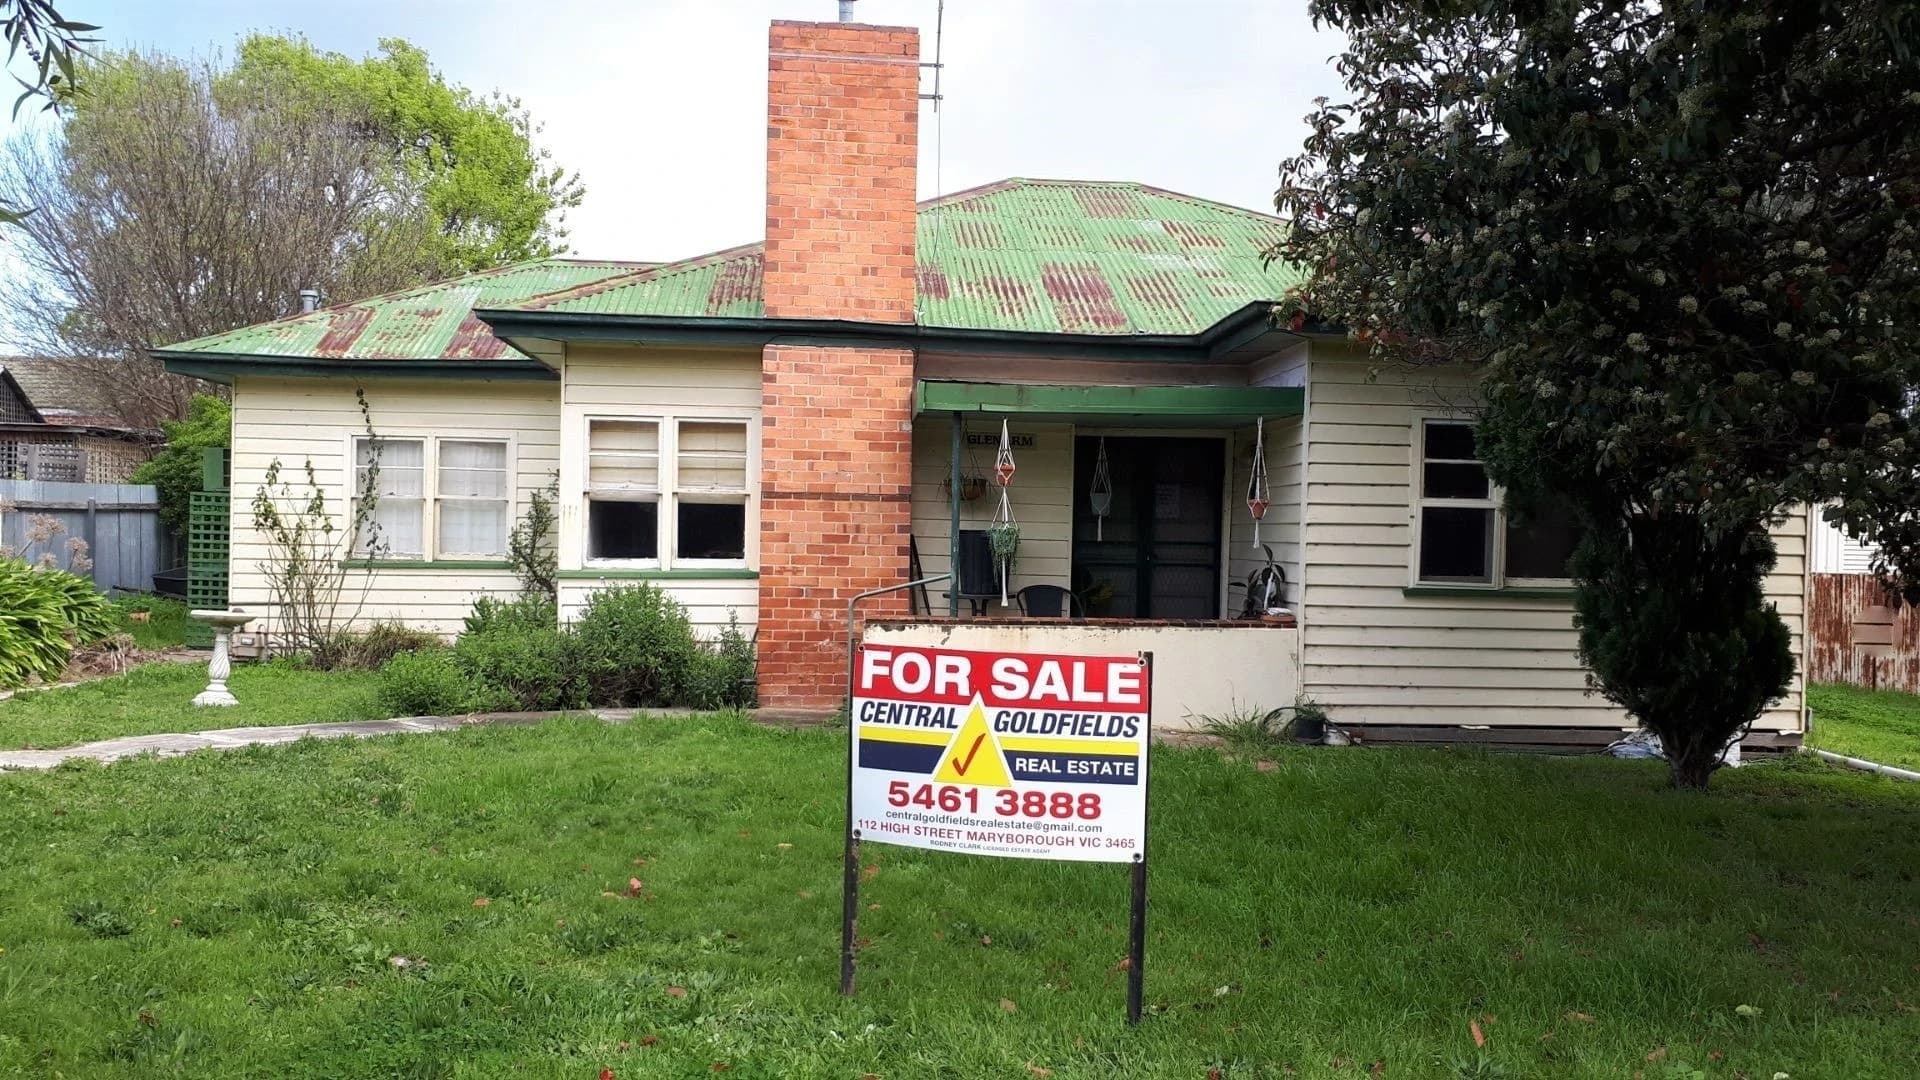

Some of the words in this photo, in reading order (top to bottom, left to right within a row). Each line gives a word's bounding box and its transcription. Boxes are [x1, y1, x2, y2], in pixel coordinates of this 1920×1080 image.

[968, 434, 1033, 446] GLENRM
[861, 650, 971, 696] FOR
[991, 657, 1141, 704] SALE
[860, 701, 958, 729] CENTRAL
[994, 710, 1140, 738] GOLDFIELDS
[1015, 758, 1061, 773] REAL
[1067, 760, 1135, 776] ESTATE
[888, 781, 978, 814] 5461
[995, 789, 1101, 820] 3888
[858, 819, 877, 830] 112
[880, 822, 910, 834] HIGH
[914, 826, 962, 840] STREET
[967, 831, 1074, 846] MARYBOROUGH
[1079, 837, 1101, 848] VIC
[1105, 838, 1135, 849] 3465
[886, 810, 1102, 833] centralgoldfieldsrealestate@gmail.com
[930, 840, 957, 848] RODNEY
